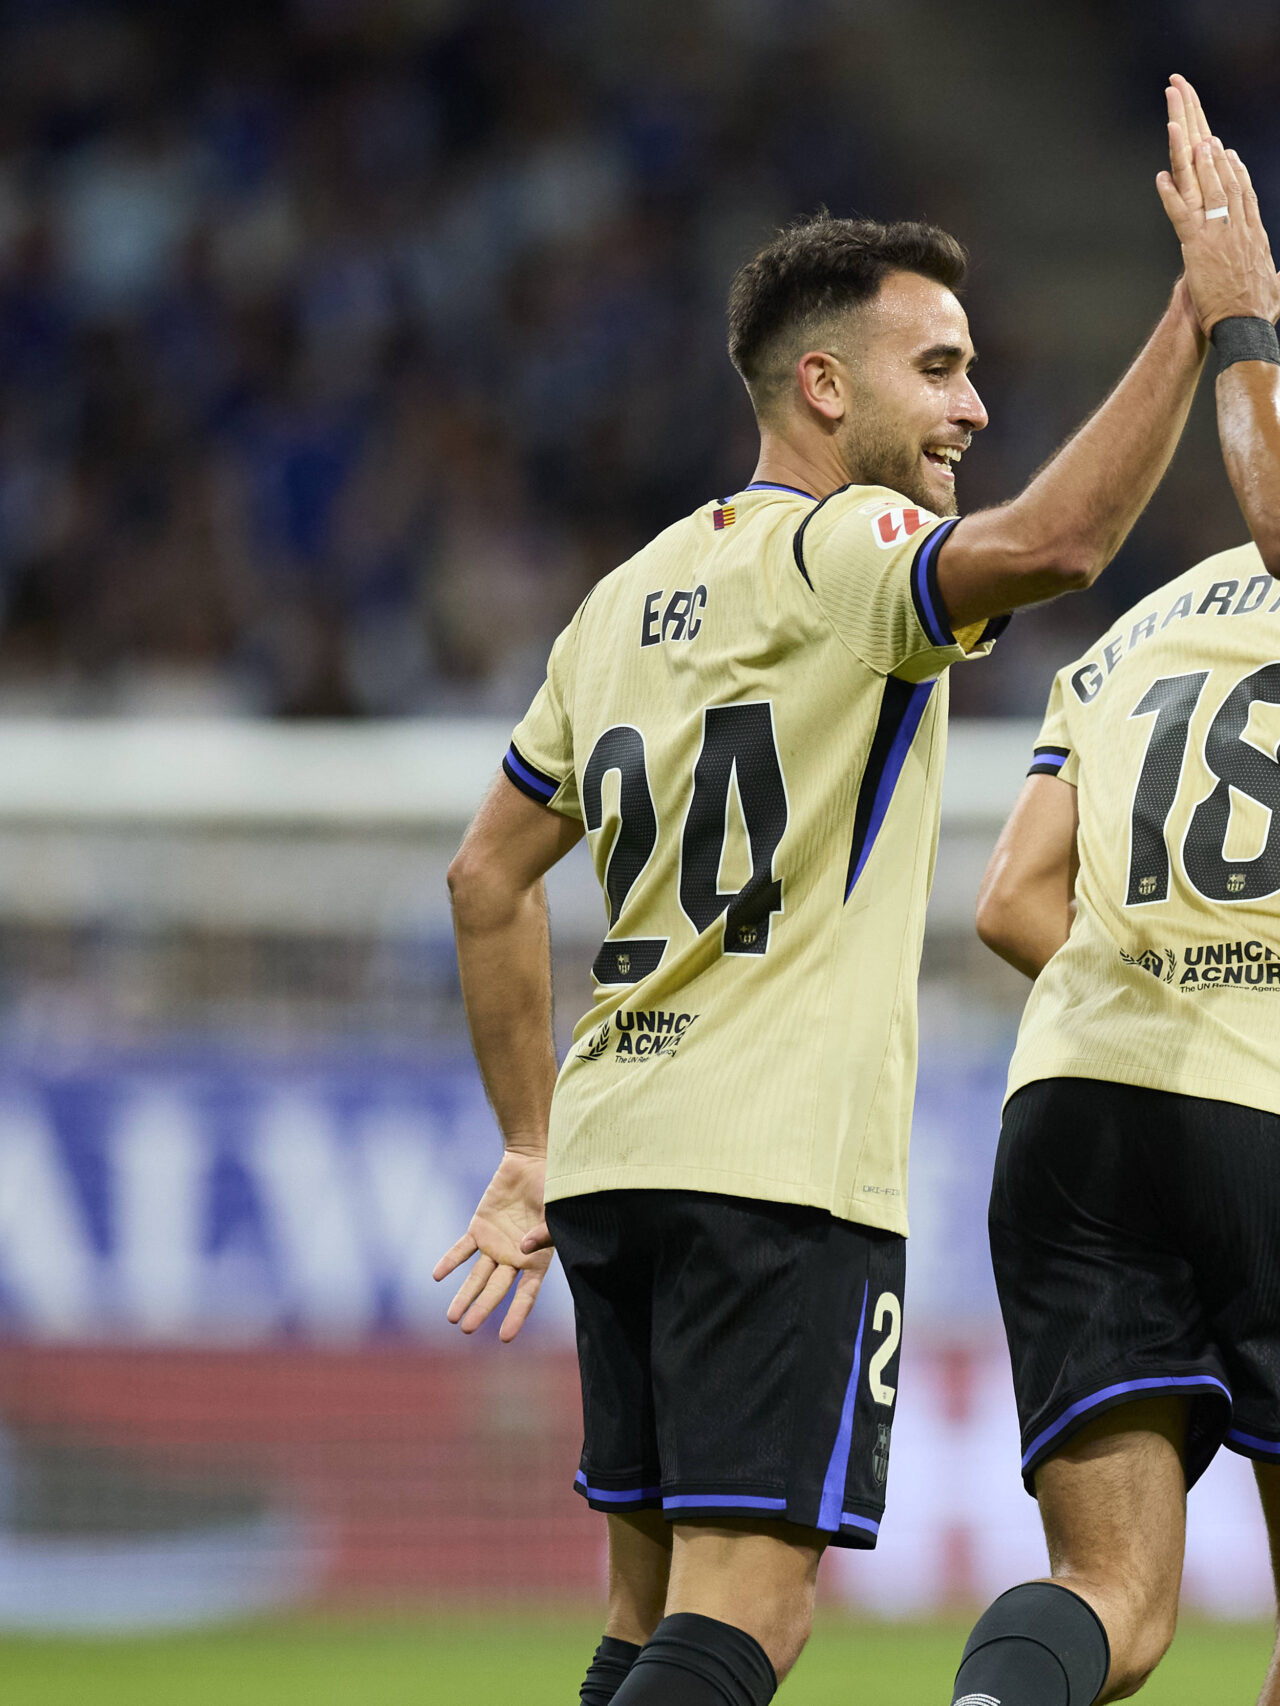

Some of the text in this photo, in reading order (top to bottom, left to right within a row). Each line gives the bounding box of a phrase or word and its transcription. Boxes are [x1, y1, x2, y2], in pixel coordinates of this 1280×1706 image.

[639, 583, 708, 649] ERC
[1071, 575, 1273, 704] GERARD
[583, 700, 789, 987] 24
[1180, 985, 1196, 993] The
[1197, 983, 1211, 991] UN
[868, 1291, 902, 1407] 2
